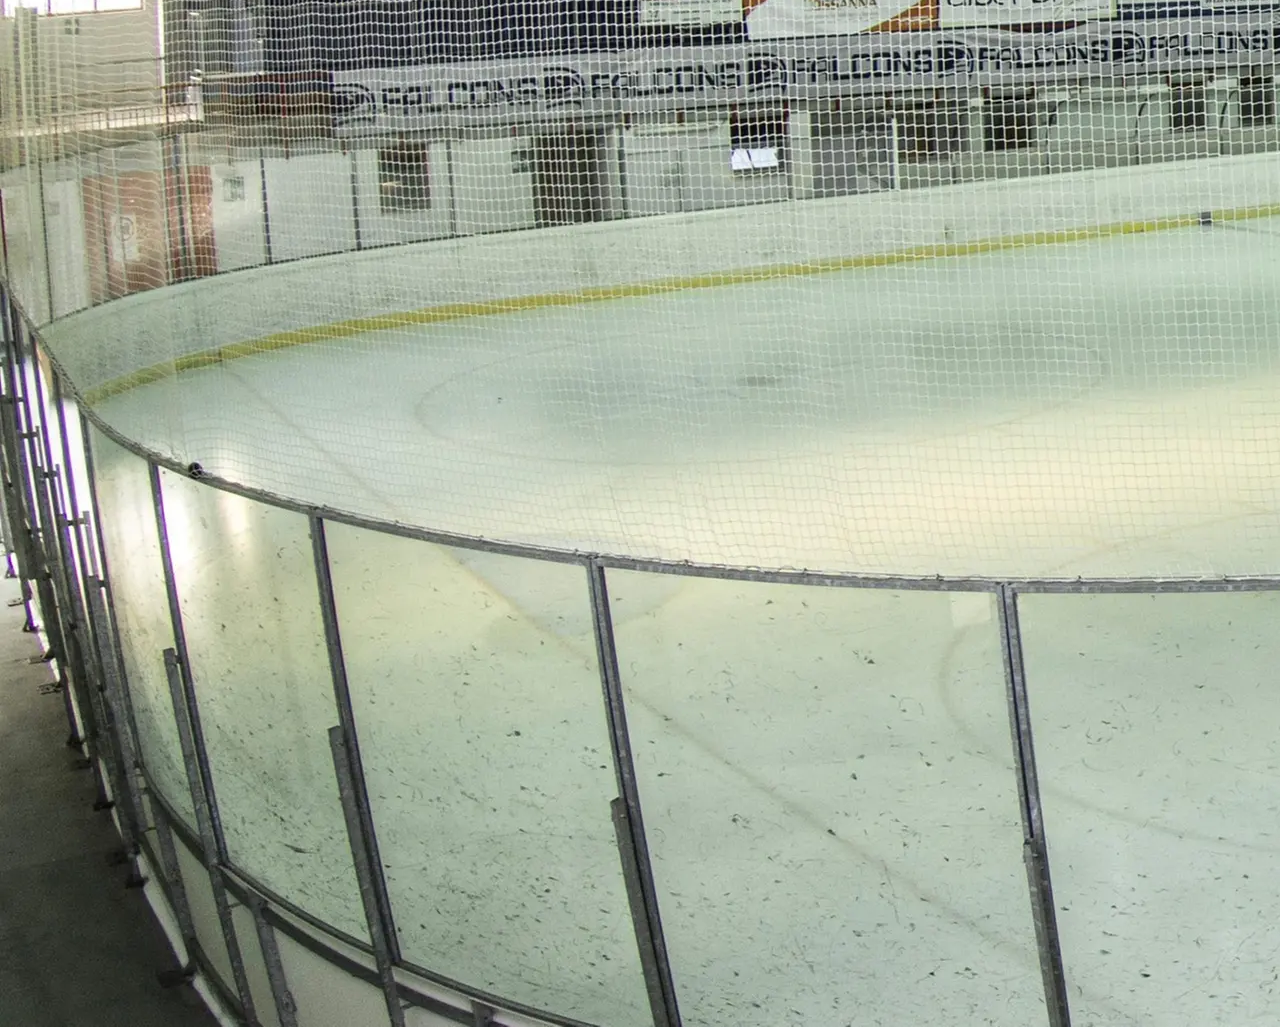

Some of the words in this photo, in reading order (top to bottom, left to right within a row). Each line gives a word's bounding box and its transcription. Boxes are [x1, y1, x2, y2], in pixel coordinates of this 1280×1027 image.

[591, 62, 741, 99] FALCONS
[792, 49, 932, 84] FALCONS
[978, 38, 1109, 72] FALCONS
[1149, 28, 1269, 59] FALCONS
